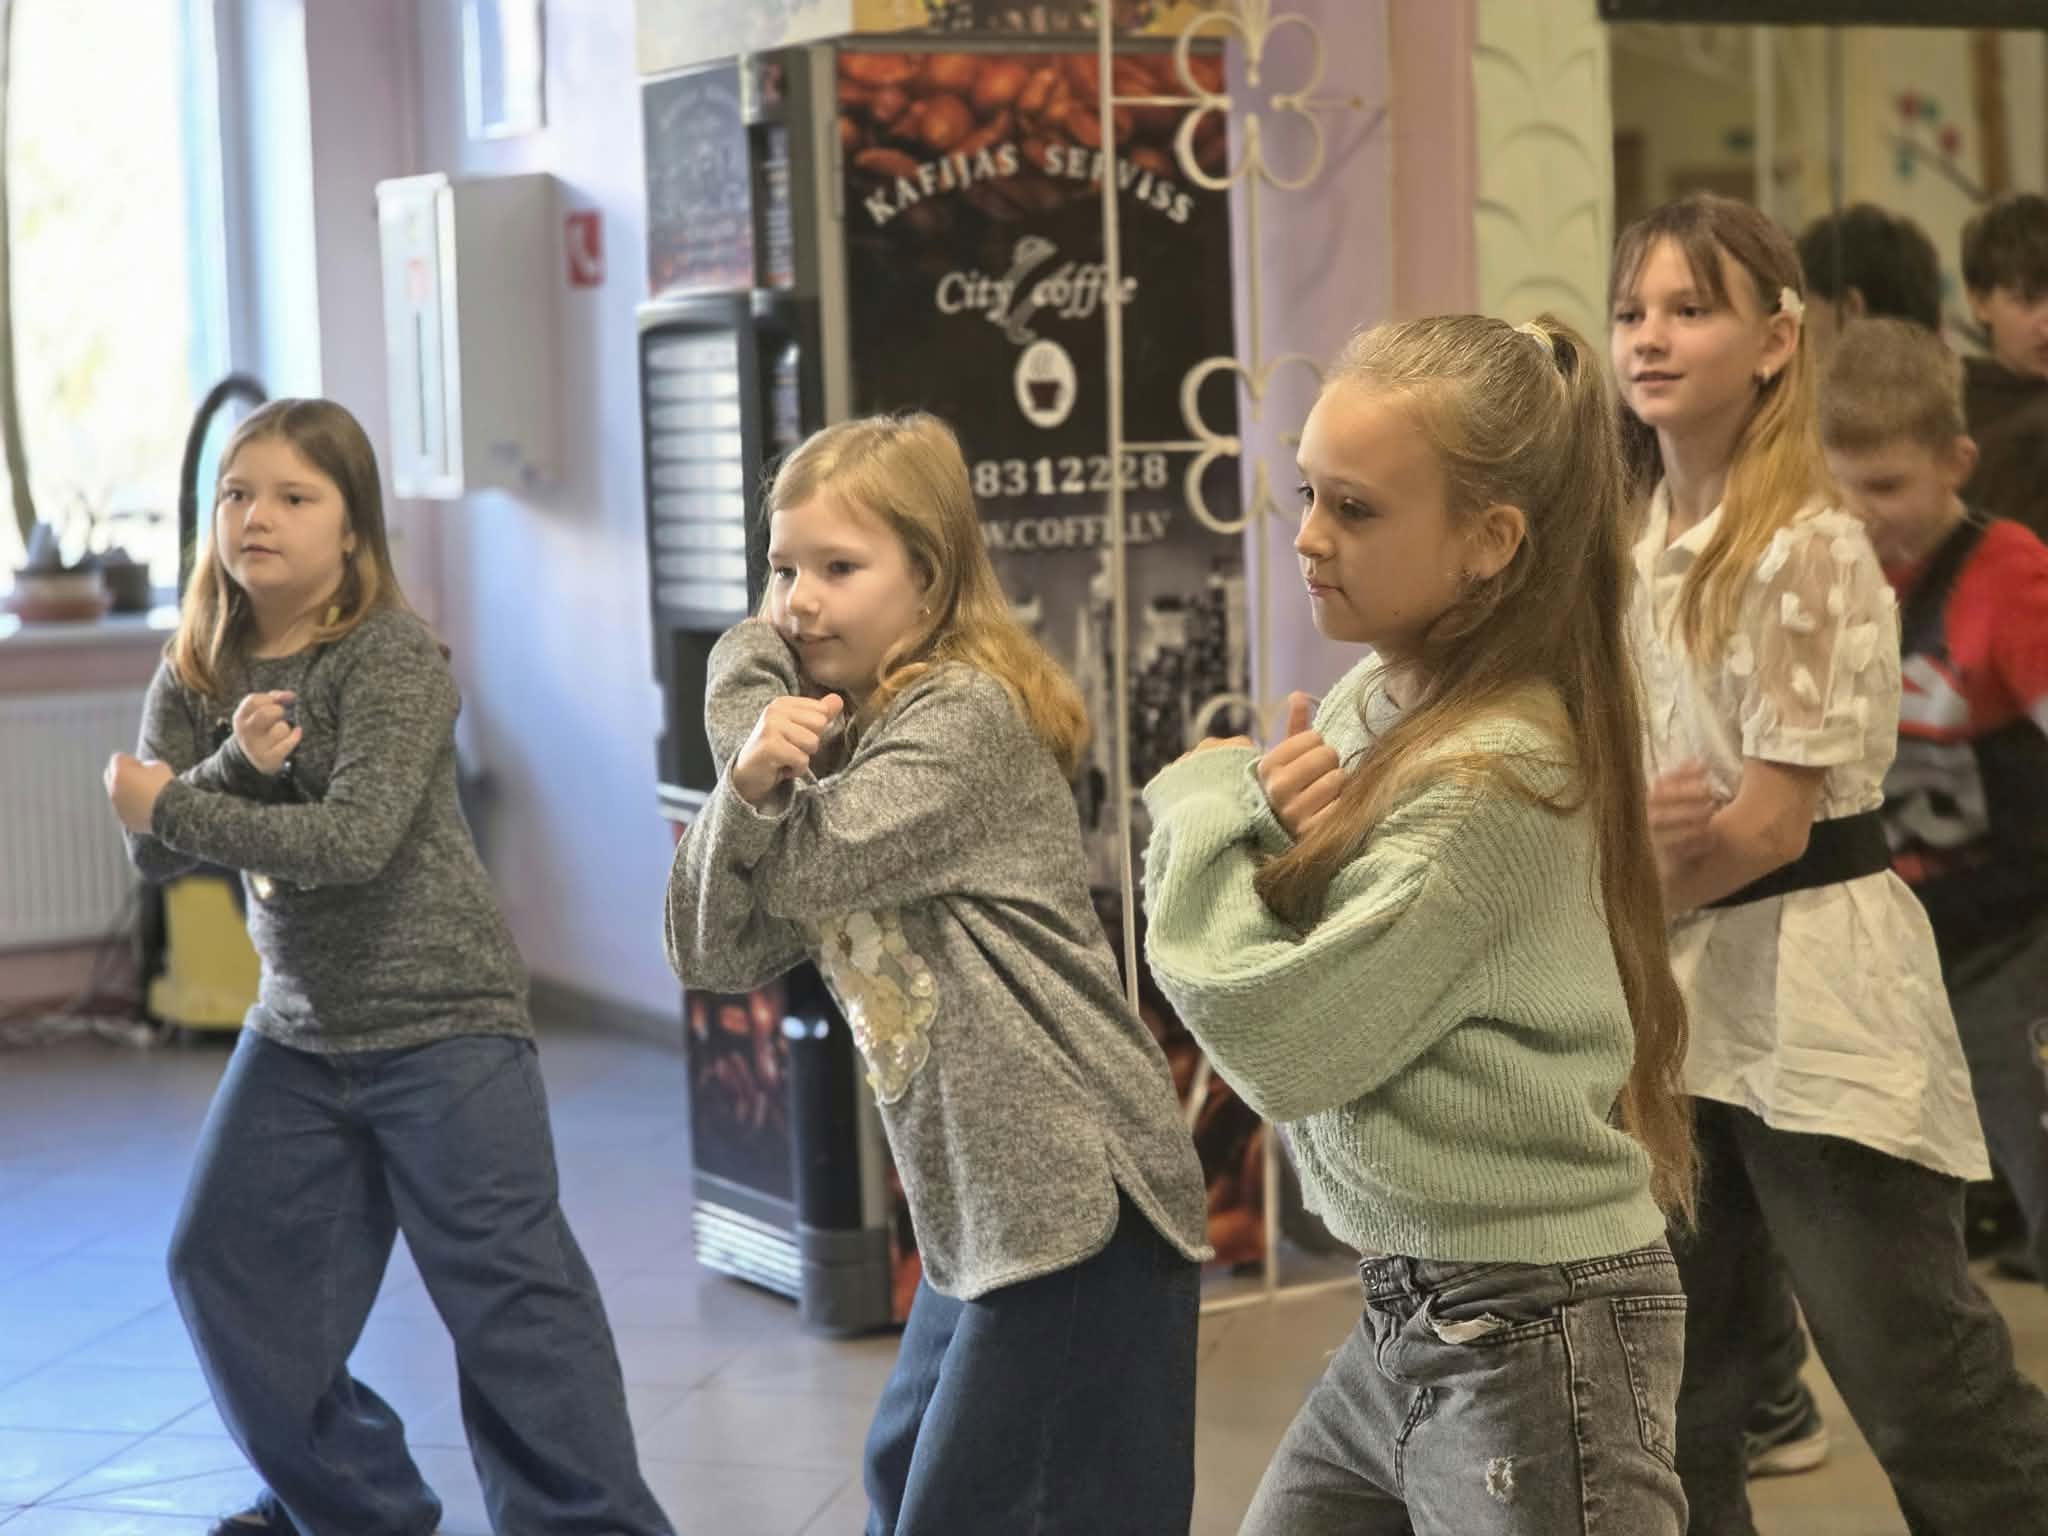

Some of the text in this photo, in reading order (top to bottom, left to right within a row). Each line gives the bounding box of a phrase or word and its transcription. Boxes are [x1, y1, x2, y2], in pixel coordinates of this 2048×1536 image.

[864, 144, 1018, 225] KAFIJAS
[935, 269, 1014, 327] City
[973, 453, 1168, 498] 8312228
